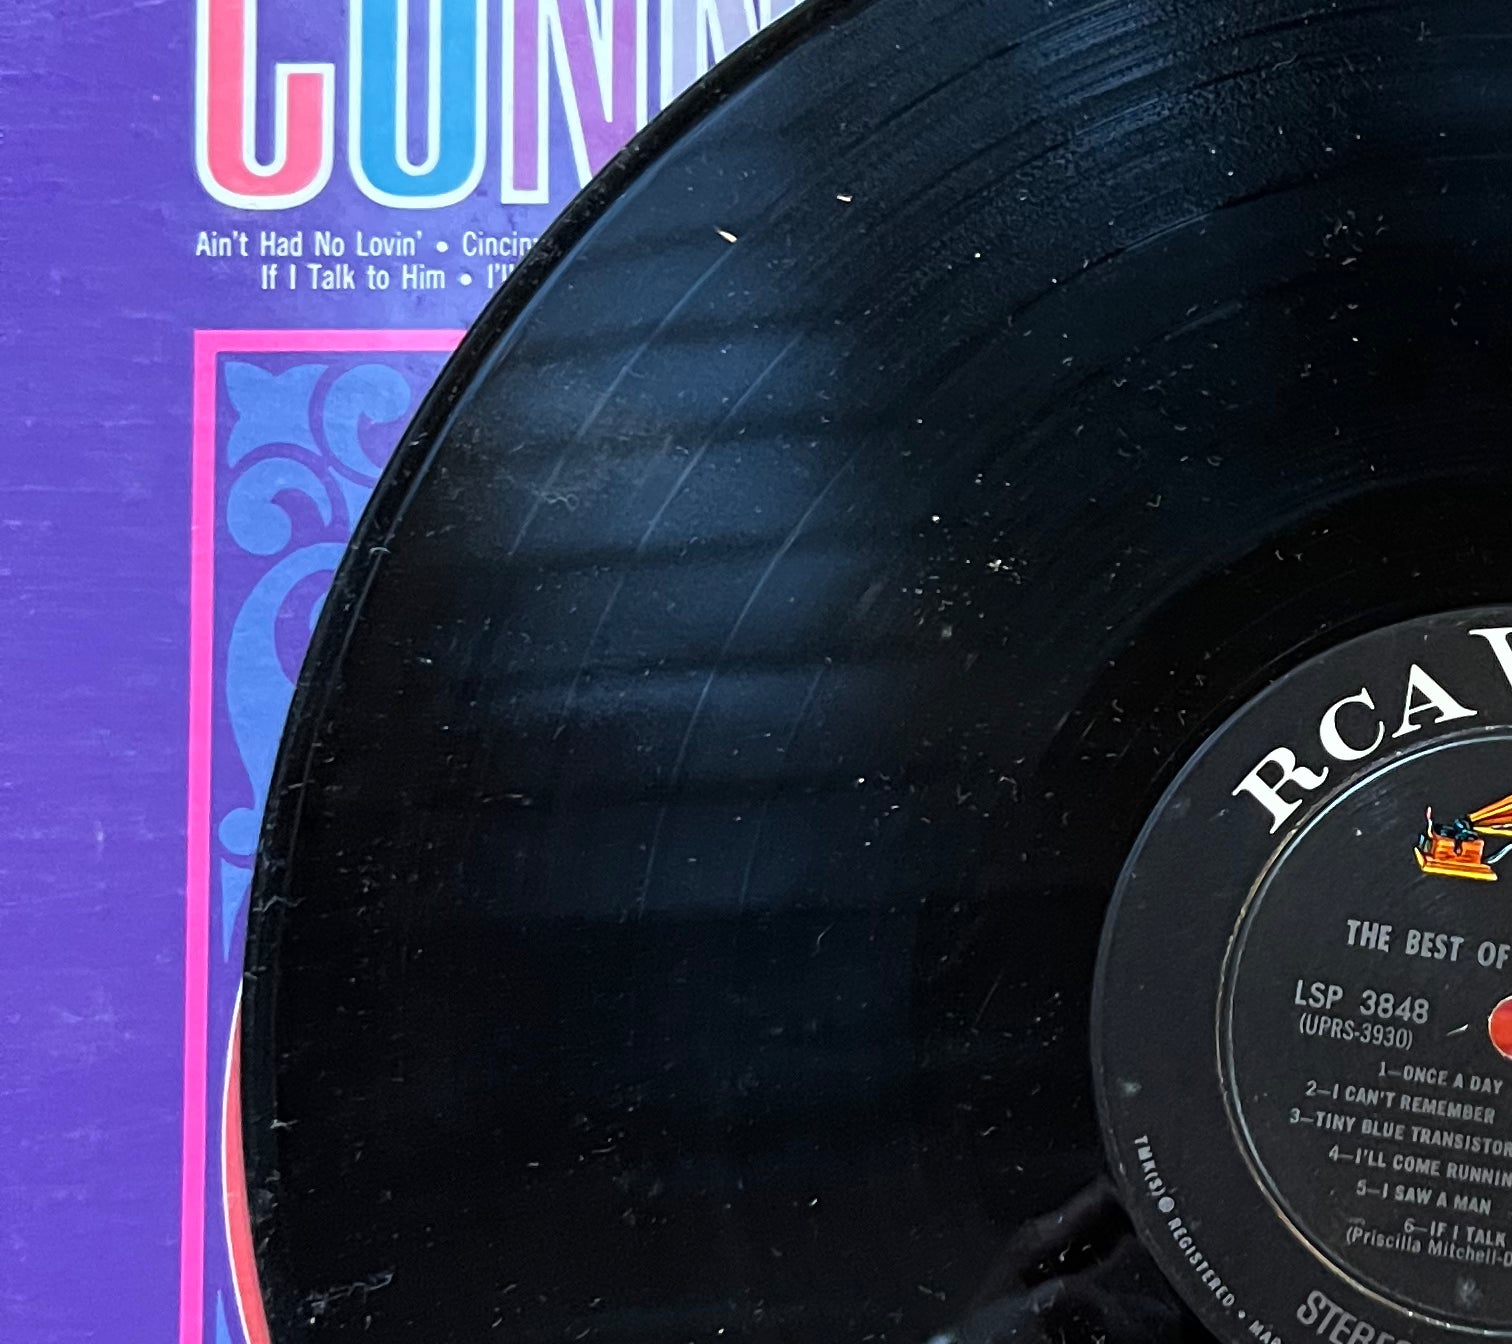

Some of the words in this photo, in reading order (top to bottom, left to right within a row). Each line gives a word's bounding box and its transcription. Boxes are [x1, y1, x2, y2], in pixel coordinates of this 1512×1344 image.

[195, 231, 248, 257] Ain't
[260, 231, 302, 257] Had
[314, 231, 345, 257] No
[357, 231, 422, 257] Lovin'
[261, 263, 278, 290] If
[290, 263, 297, 290] I
[306, 263, 355, 290] Talk
[367, 264, 389, 290] to
[402, 263, 446, 290] Him
[1232, 663, 1477, 836] RCA
[1347, 918, 1393, 953] THE
[1405, 929, 1465, 962] BEST
[1477, 941, 1511, 969] OF
[1294, 979, 1344, 1010] LSP
[1359, 988, 1430, 1025] 3848
[1299, 1012, 1413, 1051] (UPRS-3930)
[1453, 1073, 1464, 1089] A
[1469, 1075, 1503, 1095] DAY
[1345, 1086, 1396, 1106] CAN'T
[1400, 1094, 1496, 1125] REMEMBER
[1361, 1118, 1405, 1141] BLUE
[1392, 1154, 1441, 1177] COME
[1394, 1184, 1433, 1206] SAW
[1436, 1191, 1447, 1208] A
[1453, 1194, 1492, 1216] MAN
[1345, 1224, 1422, 1254] (Priscilla
[1452, 1224, 1459, 1241] I
[1465, 1225, 1507, 1248] TALK
[1167, 1217, 1236, 1307] REGISTERED
